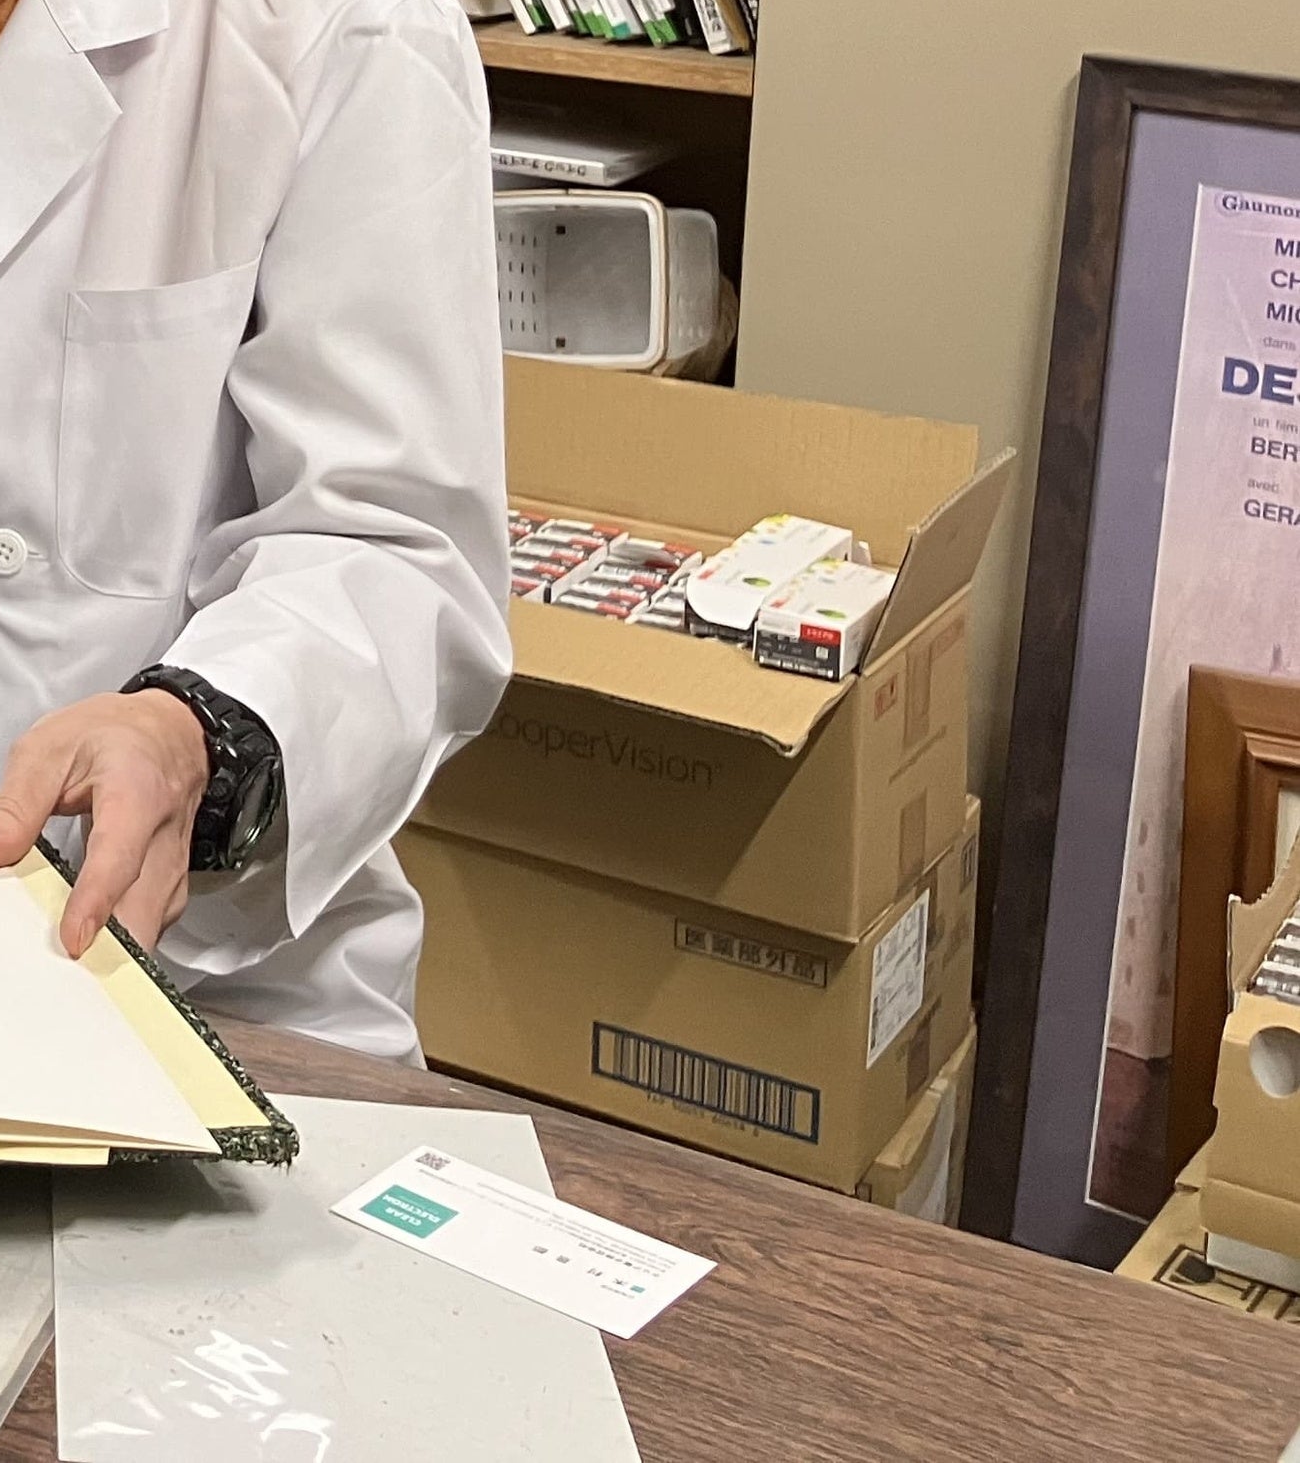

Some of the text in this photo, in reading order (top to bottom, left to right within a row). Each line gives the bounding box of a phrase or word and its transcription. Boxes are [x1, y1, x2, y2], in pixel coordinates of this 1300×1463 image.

[1262, 332, 1297, 352] dans
[1220, 356, 1300, 407] DE
[1252, 415, 1271, 429] un
[1250, 436, 1300, 465] BER
[1247, 477, 1280, 495] avec
[486, 716, 714, 789] CooperVision
[380, 1192, 442, 1225] ELECTRON
[384, 1207, 423, 1230] CLEAR
